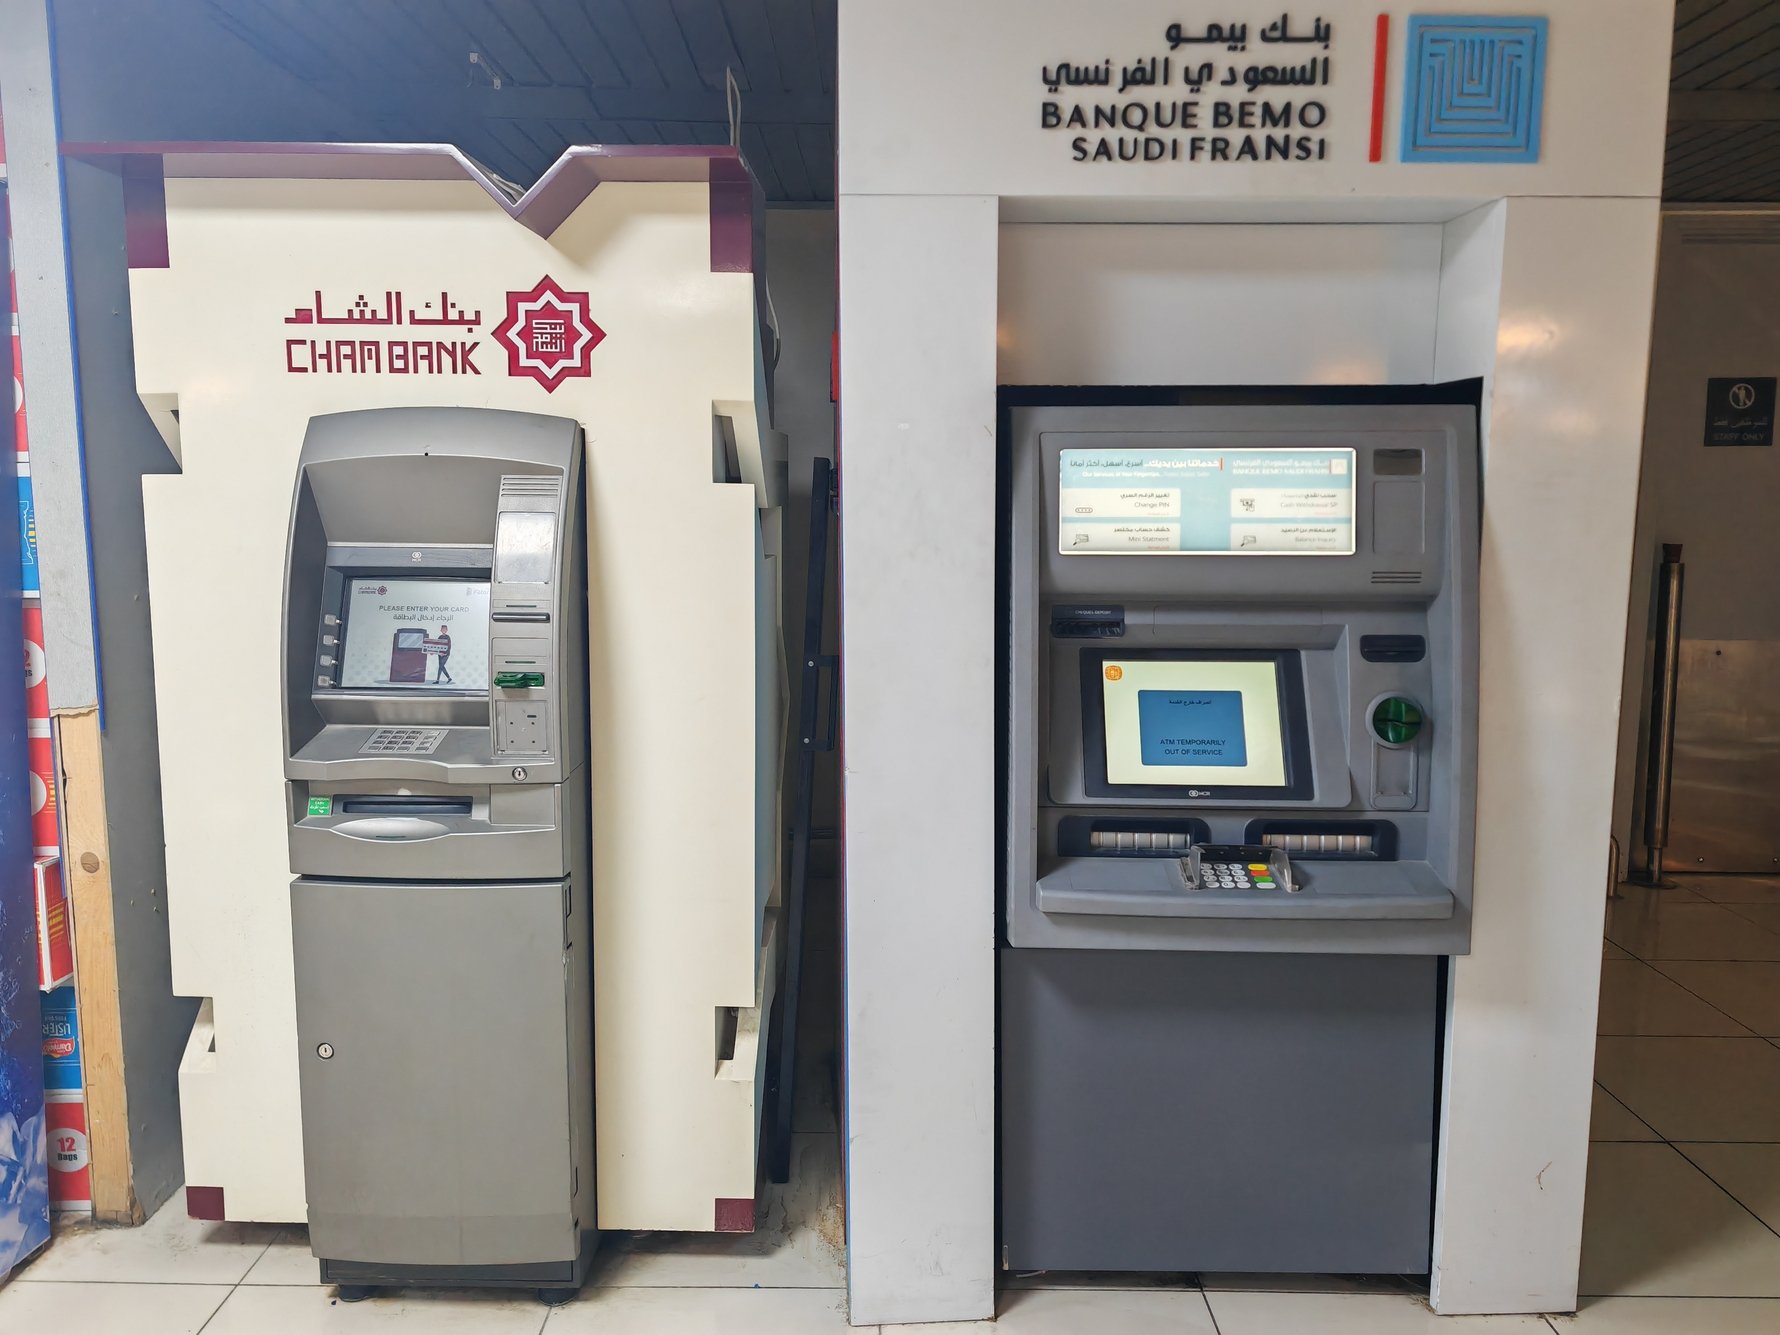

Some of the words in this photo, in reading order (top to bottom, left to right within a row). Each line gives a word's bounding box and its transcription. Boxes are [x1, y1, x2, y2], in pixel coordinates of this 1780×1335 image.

[1165, 18, 1247, 52] بيمو
[1260, 13, 1331, 50] بنك
[1041, 56, 1170, 94] الفرنسي
[1184, 56, 1330, 94] السعودي
[1041, 101, 1200, 133] BANQUE
[1212, 101, 1328, 130] BEMO
[1071, 136, 1178, 163] SAUDI
[1190, 134, 1327, 162] FRANSI
[284, 290, 403, 326] الشام
[409, 291, 482, 334] بنك
[57, 1136, 76, 1152] 12
[57, 1152, 78, 1162] Bags
